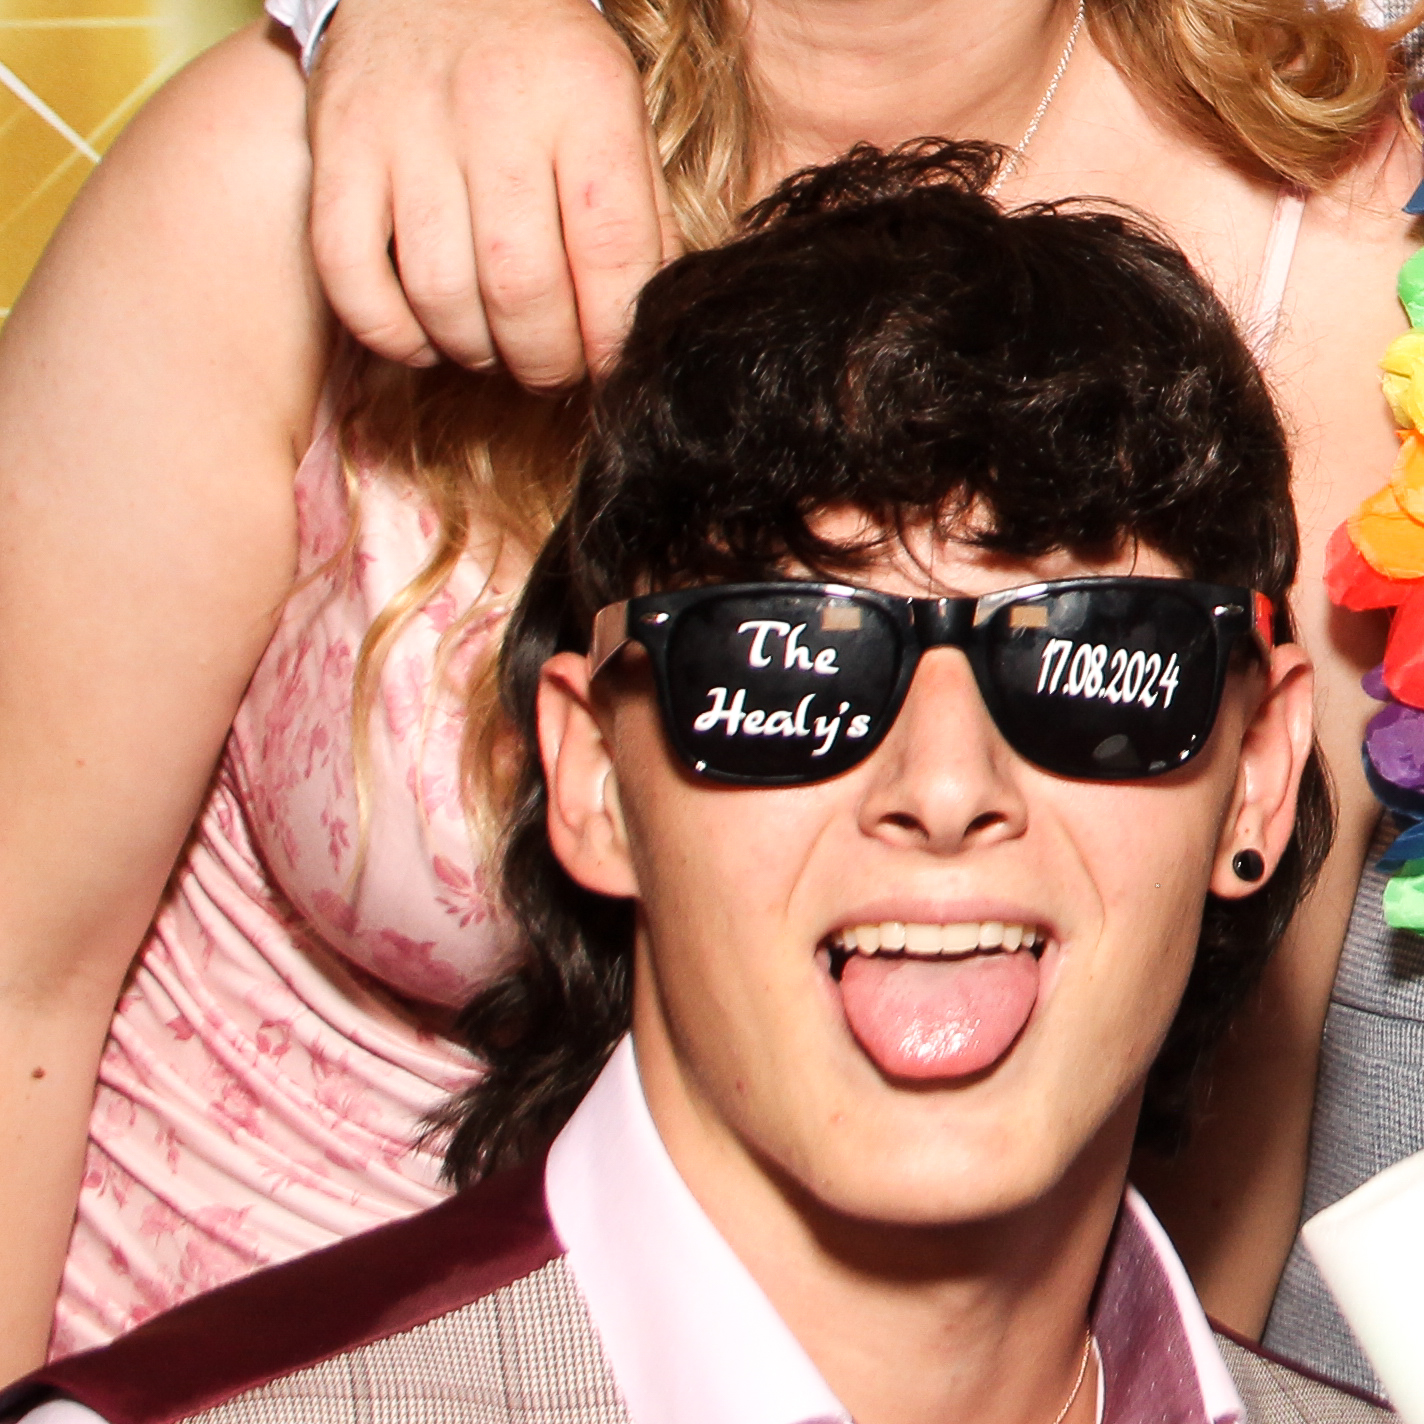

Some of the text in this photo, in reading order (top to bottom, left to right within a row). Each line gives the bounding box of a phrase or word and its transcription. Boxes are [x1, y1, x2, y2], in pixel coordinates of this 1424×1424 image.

[737, 620, 840, 675] The
[1037, 638, 1181, 708] 17.08.2024
[694, 687, 871, 756] Healy's
